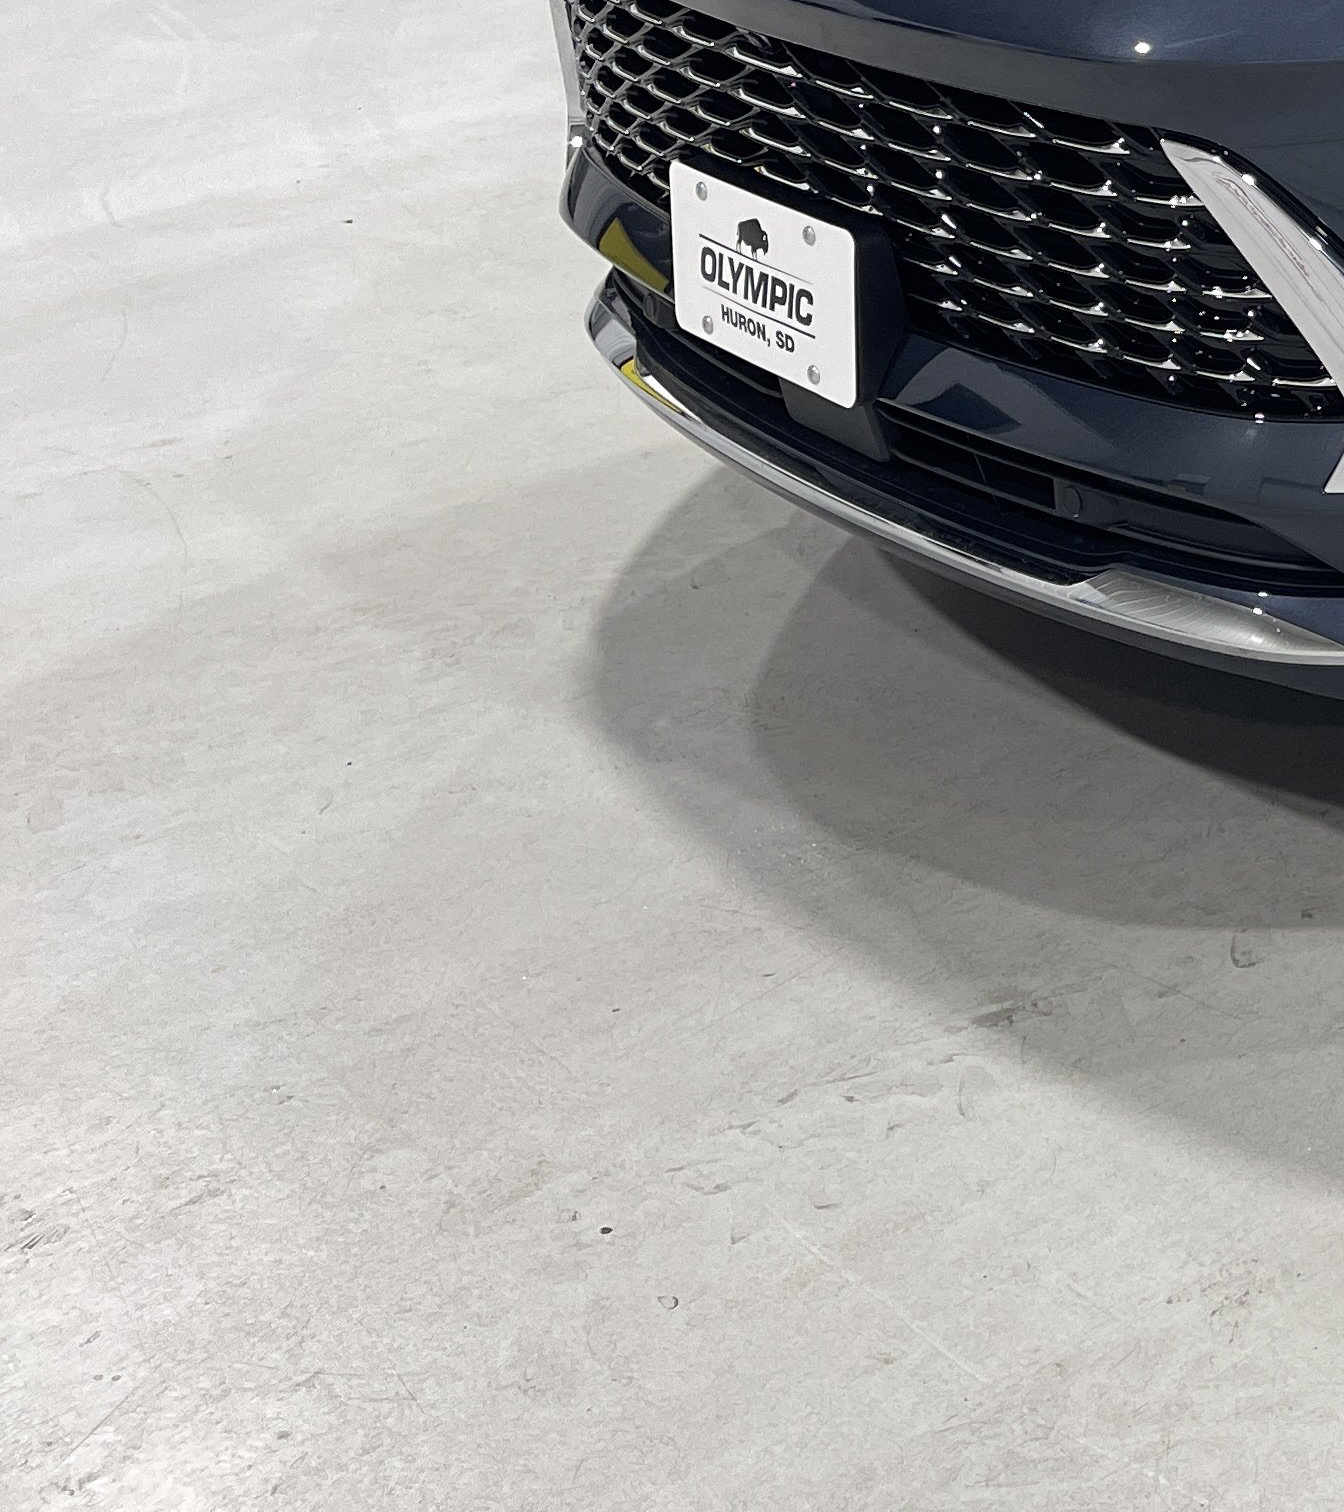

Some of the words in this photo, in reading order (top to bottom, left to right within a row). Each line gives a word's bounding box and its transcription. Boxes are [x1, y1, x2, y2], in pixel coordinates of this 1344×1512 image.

[700, 246, 815, 327] OLYMPIC
[720, 303, 771, 347] HURON,
[775, 329, 795, 353] SD
